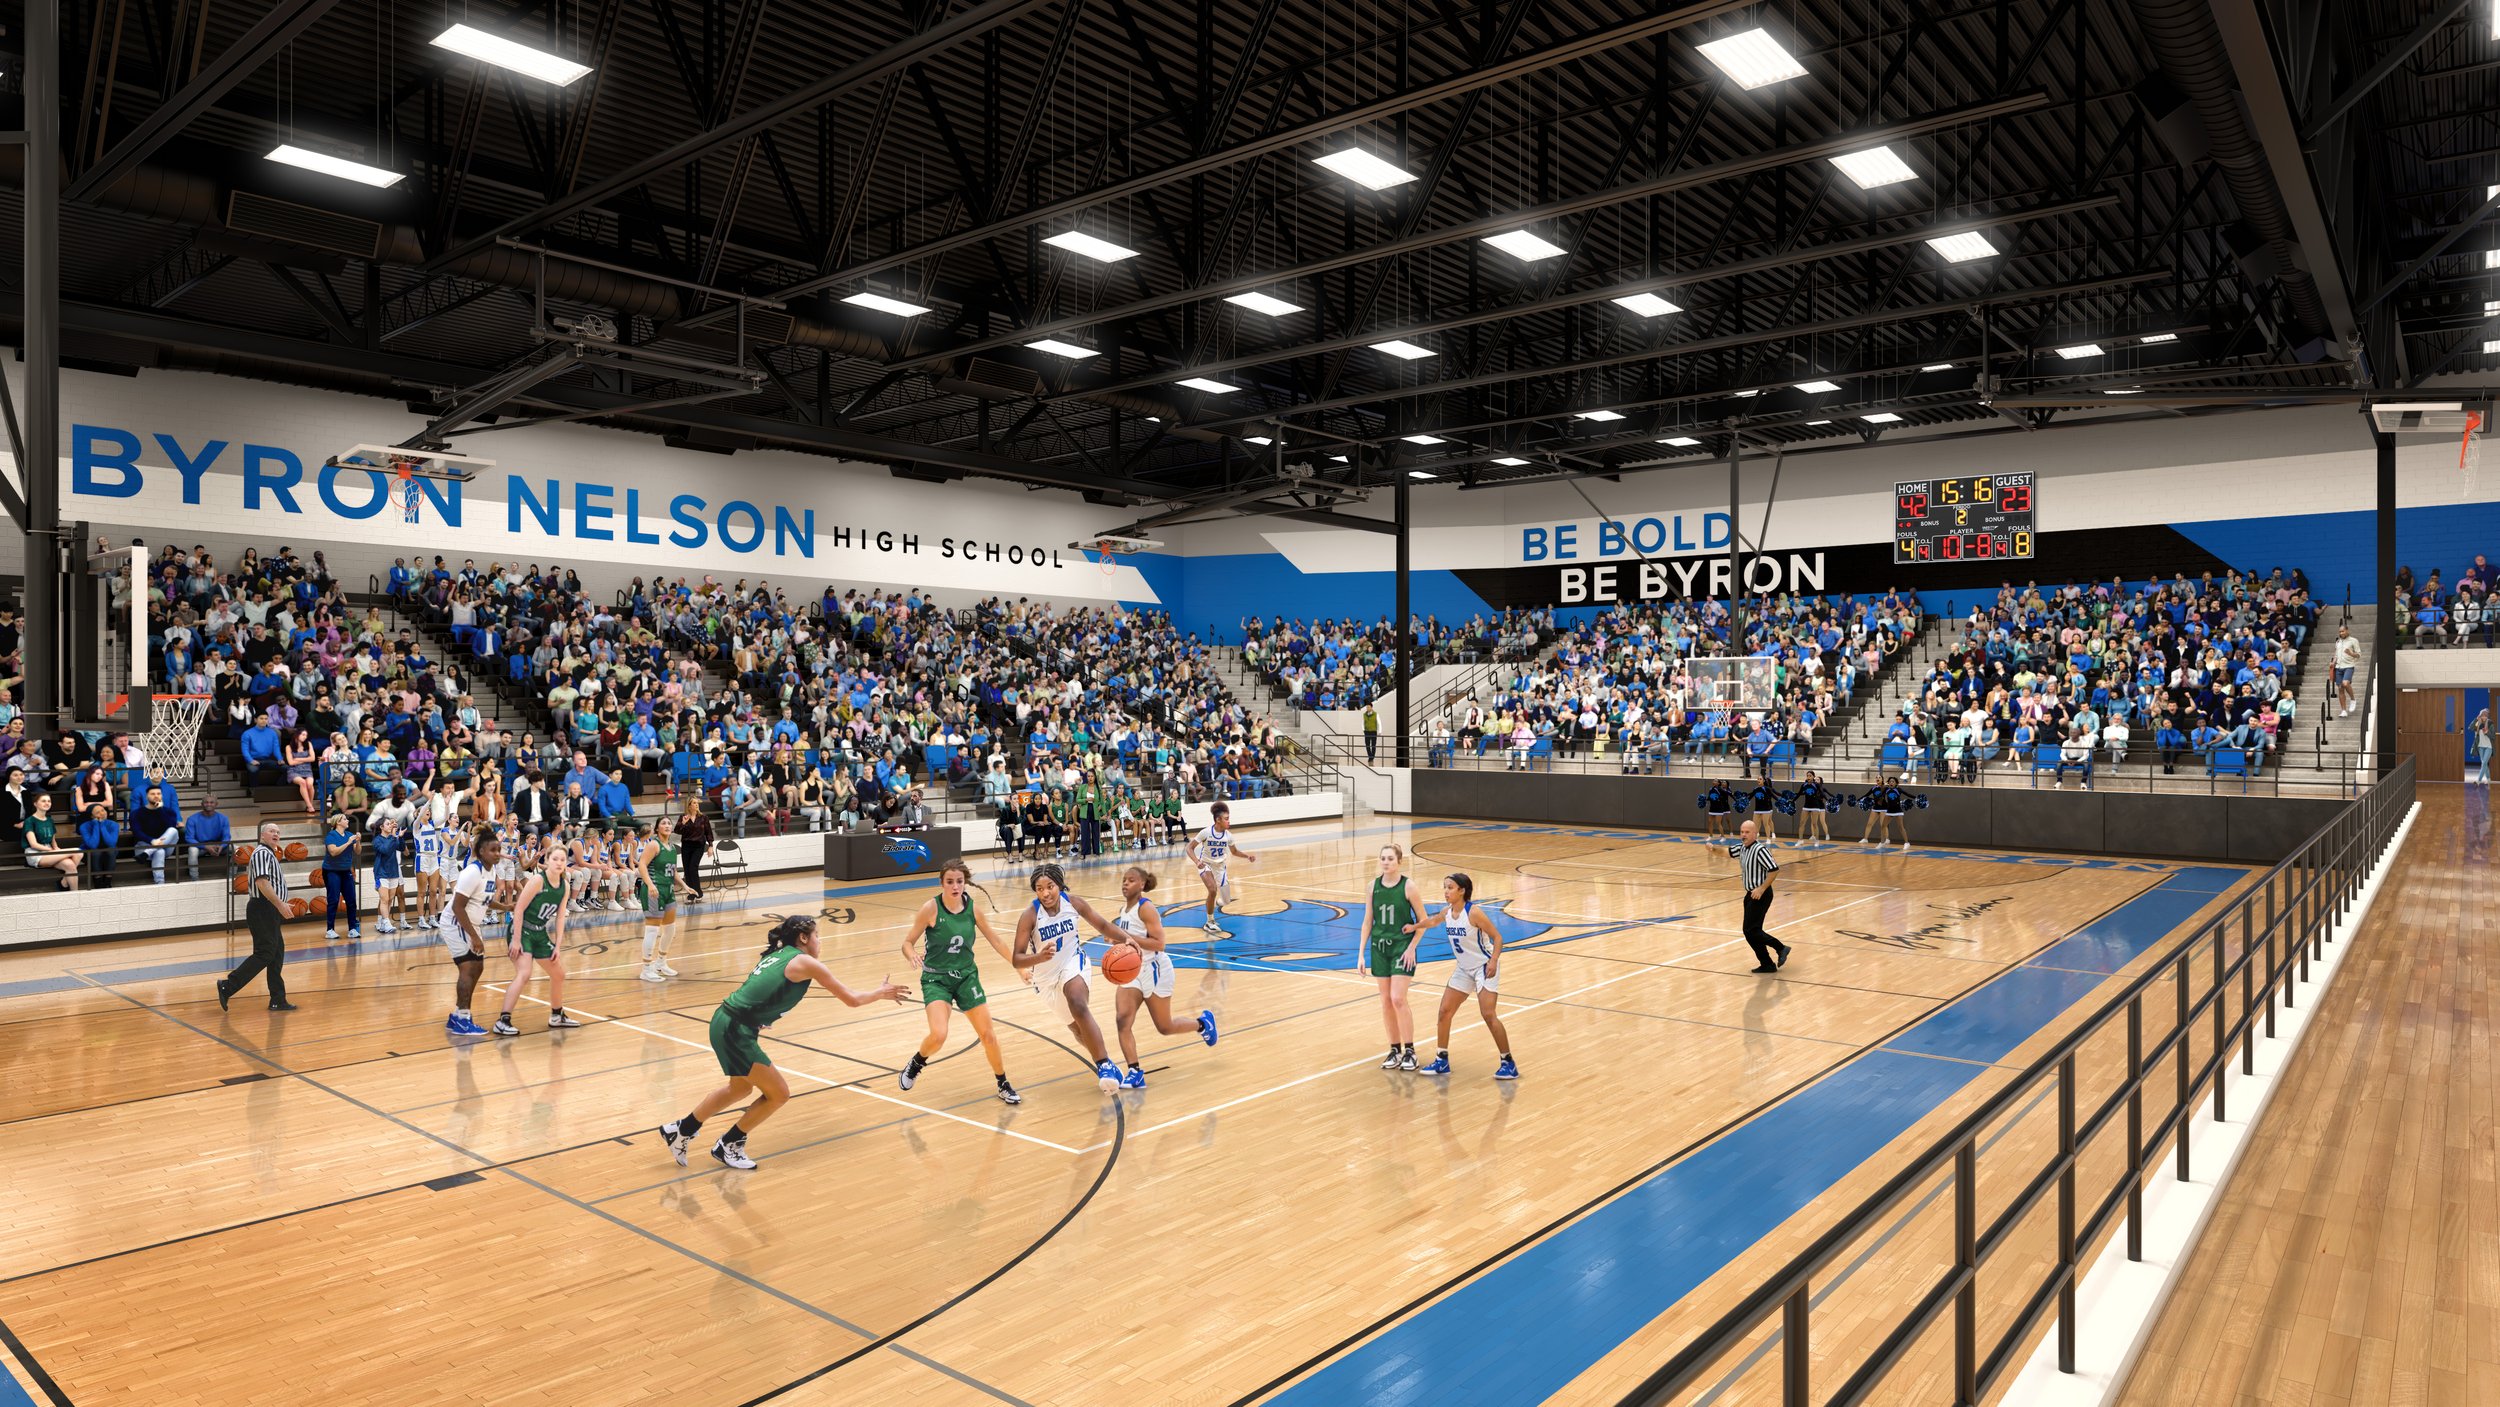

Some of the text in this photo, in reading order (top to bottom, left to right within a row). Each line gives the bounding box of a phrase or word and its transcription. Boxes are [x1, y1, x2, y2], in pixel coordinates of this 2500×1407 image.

[1898, 483, 1927, 494] HOME
[1996, 475, 2031, 487] GUEST
[72, 424, 815, 559] BYRON NELSON
[2002, 486, 2030, 511] 23
[1900, 494, 1927, 517] 42
[1957, 510, 1967, 524] 2
[1523, 512, 1731, 561] BE BOLD
[2015, 532, 2030, 556] 8
[834, 526, 1063, 568] HIGH SCHOOL
[1901, 539, 1914, 559] 4
[1919, 545, 1929, 559] 4
[1996, 542, 2006, 555] 4
[1561, 552, 1825, 603] BE BYRON
[1057, 810, 1063, 818] 8
[423, 838, 434, 852] 21
[1379, 903, 1395, 925] 11
[1038, 919, 1074, 942] BOBCATS
[1446, 926, 1467, 937] BOBCATS
[947, 935, 964, 954] 2
[1453, 938, 1464, 954] 5
[971, 986, 983, 1000] L
